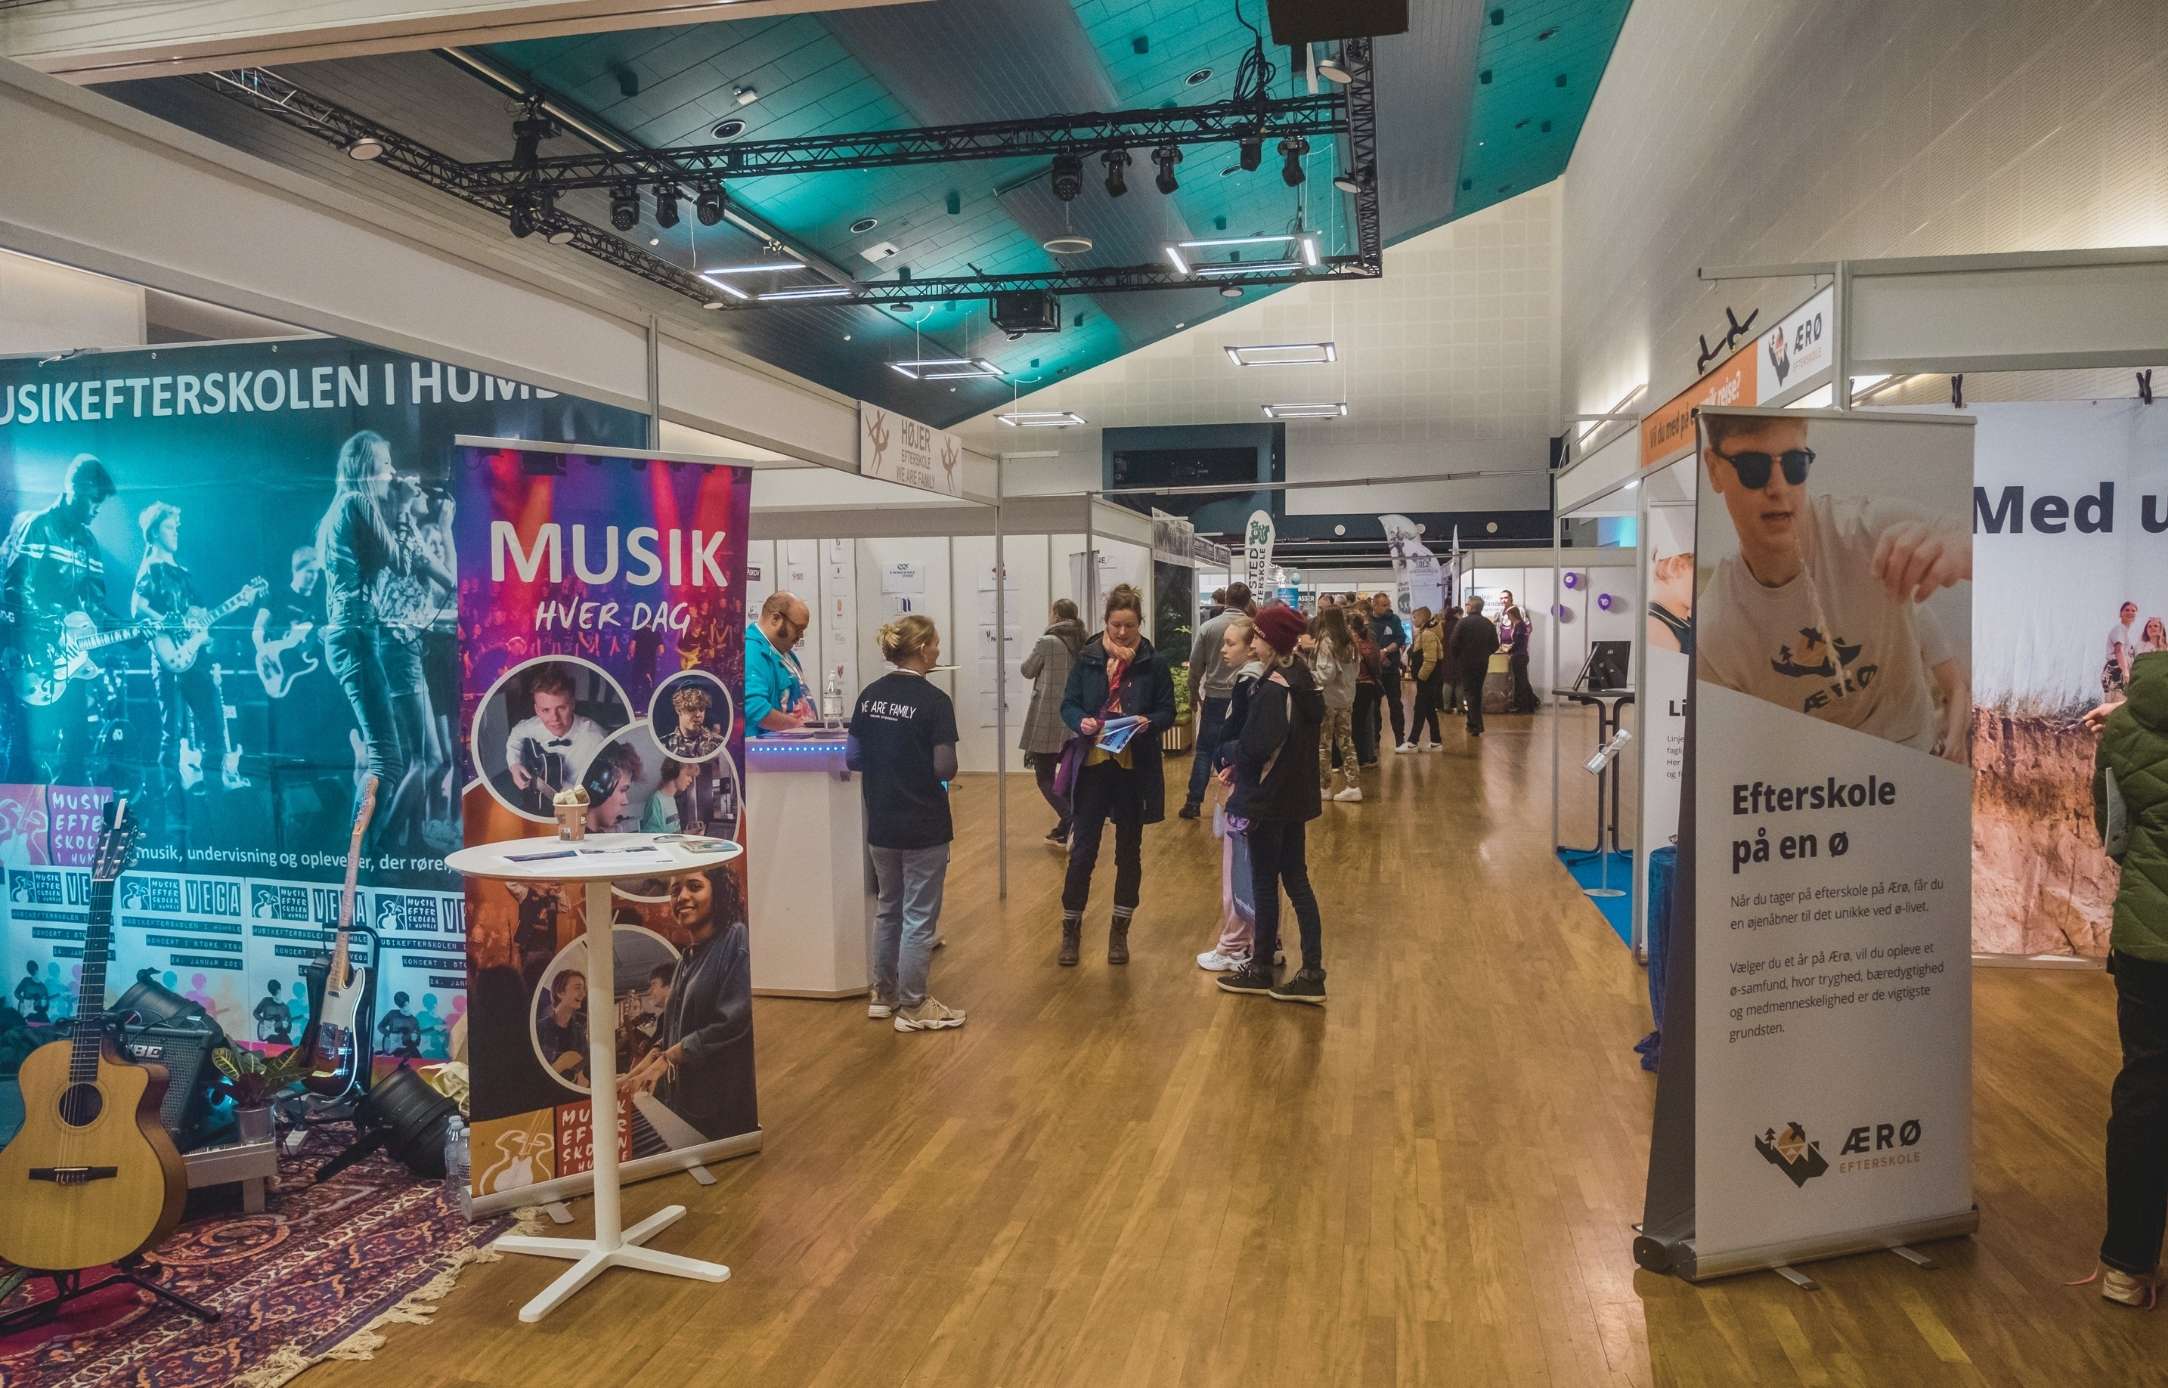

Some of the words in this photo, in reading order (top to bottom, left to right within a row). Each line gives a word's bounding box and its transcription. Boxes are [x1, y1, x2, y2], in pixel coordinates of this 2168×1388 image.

[1793, 312, 1822, 354] ÆRØ
[385, 363, 395, 405] I
[411, 362, 559, 404] HUM
[901, 420, 931, 452] HØJER
[1973, 481, 2114, 534] Med
[491, 520, 728, 587] MUSIK
[536, 596, 621, 632] HVER
[632, 601, 690, 639] DAG
[871, 700, 888, 714] ARE
[889, 703, 917, 719] FAMILY
[1669, 699, 1686, 716] Li
[53, 792, 110, 810] MUSIK
[1733, 775, 1896, 815] Efterskole
[56, 814, 104, 833] EFTE
[56, 834, 99, 850] SKOL
[1732, 827, 1770, 874] på
[1780, 833, 1817, 859] en
[1829, 831, 1849, 858] ø
[136, 845, 183, 864] musik,
[188, 847, 277, 867] undervisning
[280, 852, 298, 868] og
[301, 851, 374, 872] opleveer,
[380, 853, 406, 870] der
[68, 875, 89, 903] VE
[187, 882, 240, 913] VEGA
[407, 898, 436, 907] MUSIK
[1730, 894, 1750, 908] Når
[1753, 892, 1767, 906] du
[1769, 890, 1799, 907] tager
[1798, 888, 1812, 904] på
[1815, 883, 1869, 900] efterskole
[1872, 882, 1885, 898] på
[1888, 882, 1911, 896] Ærø,
[1914, 879, 1928, 892] får
[1930, 878, 1944, 891] du
[314, 891, 366, 923] VEA
[408, 908, 436, 916] EFTER
[443, 900, 466, 930] VE
[1730, 920, 1744, 930] en
[1748, 912, 1798, 932] øjenåbner
[1801, 910, 1811, 922] til
[1814, 907, 1832, 921] det
[1835, 905, 1870, 920] unikke
[1873, 903, 1892, 916] ved
[1894, 902, 1929, 915] ø-livet.
[381, 939, 457, 950] USIKEFTERSKOLEN
[1730, 960, 1766, 975] Vælger
[1768, 958, 1782, 971] du
[1784, 956, 1795, 968] et
[1797, 953, 1808, 966] år
[1812, 951, 1825, 966] på
[1828, 950, 1852, 964] Ærø,
[1856, 948, 1867, 960] vil
[1870, 946, 1884, 959] du
[1887, 944, 1922, 960] opleve
[1924, 943, 1934, 954] et
[1730, 977, 1788, 997] ø-samfund,
[1792, 976, 1815, 988] hvor
[1818, 970, 1863, 988] tryghed,
[1866, 961, 1944, 981] bæredygtighed
[1730, 1007, 1743, 1021] og
[1746, 991, 1855, 1017] medmenneskelighed
[1858, 992, 1869, 1002] er
[1872, 988, 1885, 1001] de
[1888, 984, 1931, 1002] vigtigste
[1729, 1023, 1785, 1044] grundsten.
[562, 1099, 626, 1127] MUK
[563, 1118, 628, 1146] EFR
[1840, 1119, 1921, 1156] ÆRØ
[562, 1135, 627, 1162] SKON
[578, 1150, 629, 1172] HUE
[1840, 1152, 1920, 1174] EFTERSKOLE
